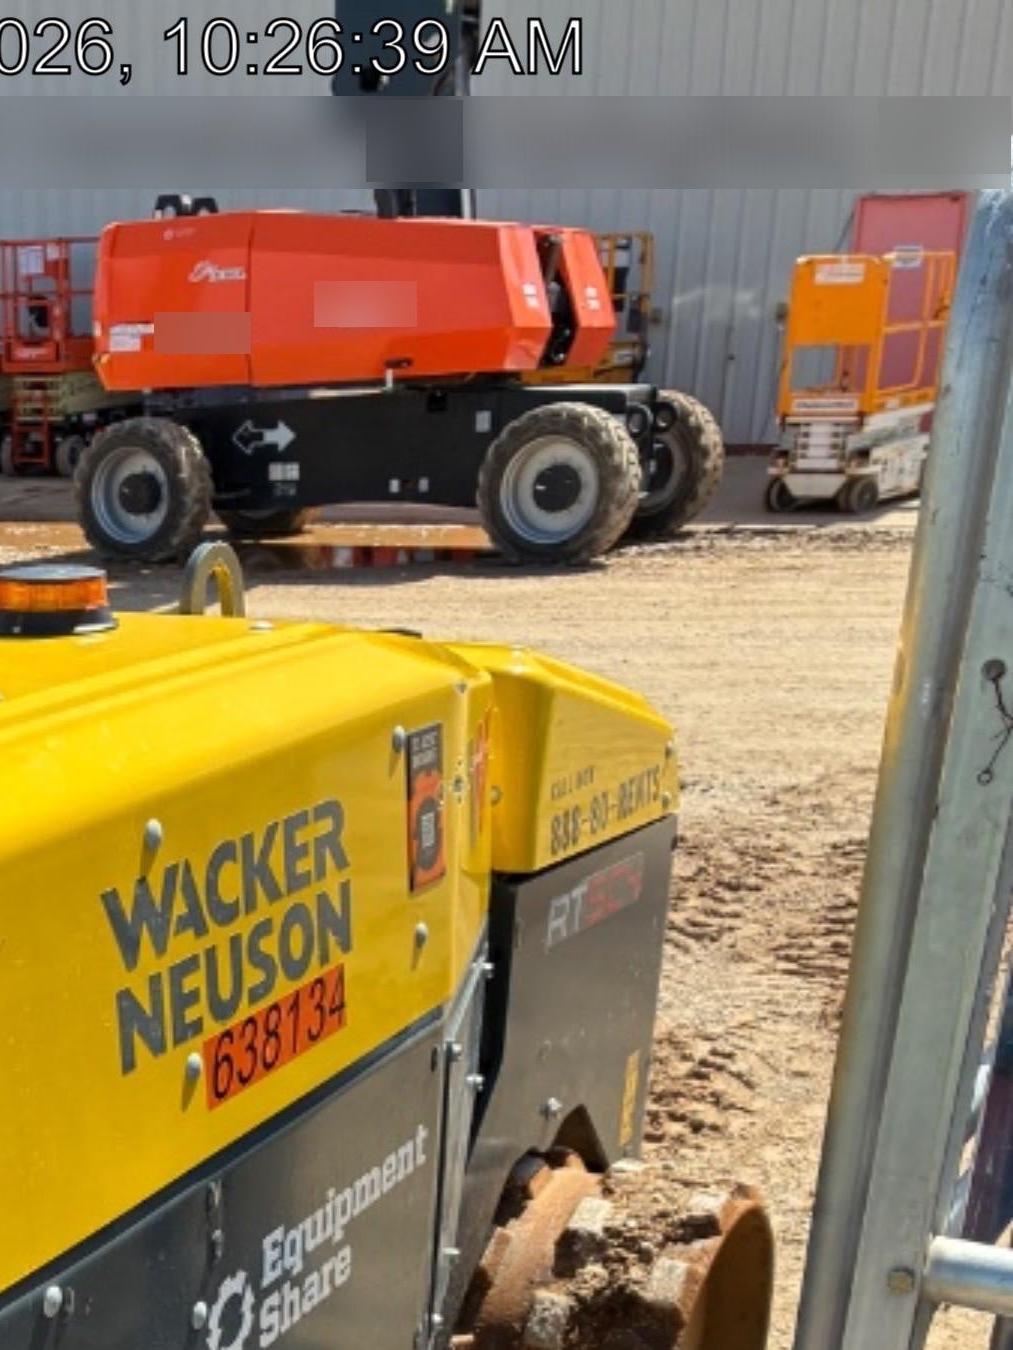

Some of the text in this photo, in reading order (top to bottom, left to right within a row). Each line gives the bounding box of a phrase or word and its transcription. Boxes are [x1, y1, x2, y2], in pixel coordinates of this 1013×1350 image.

[100, 798, 350, 973] WACKER
[115, 879, 353, 1077] NEUSON
[210, 964, 346, 1101] 638134
[261, 1123, 429, 1288] Equipment
[259, 1244, 352, 1348] Share
